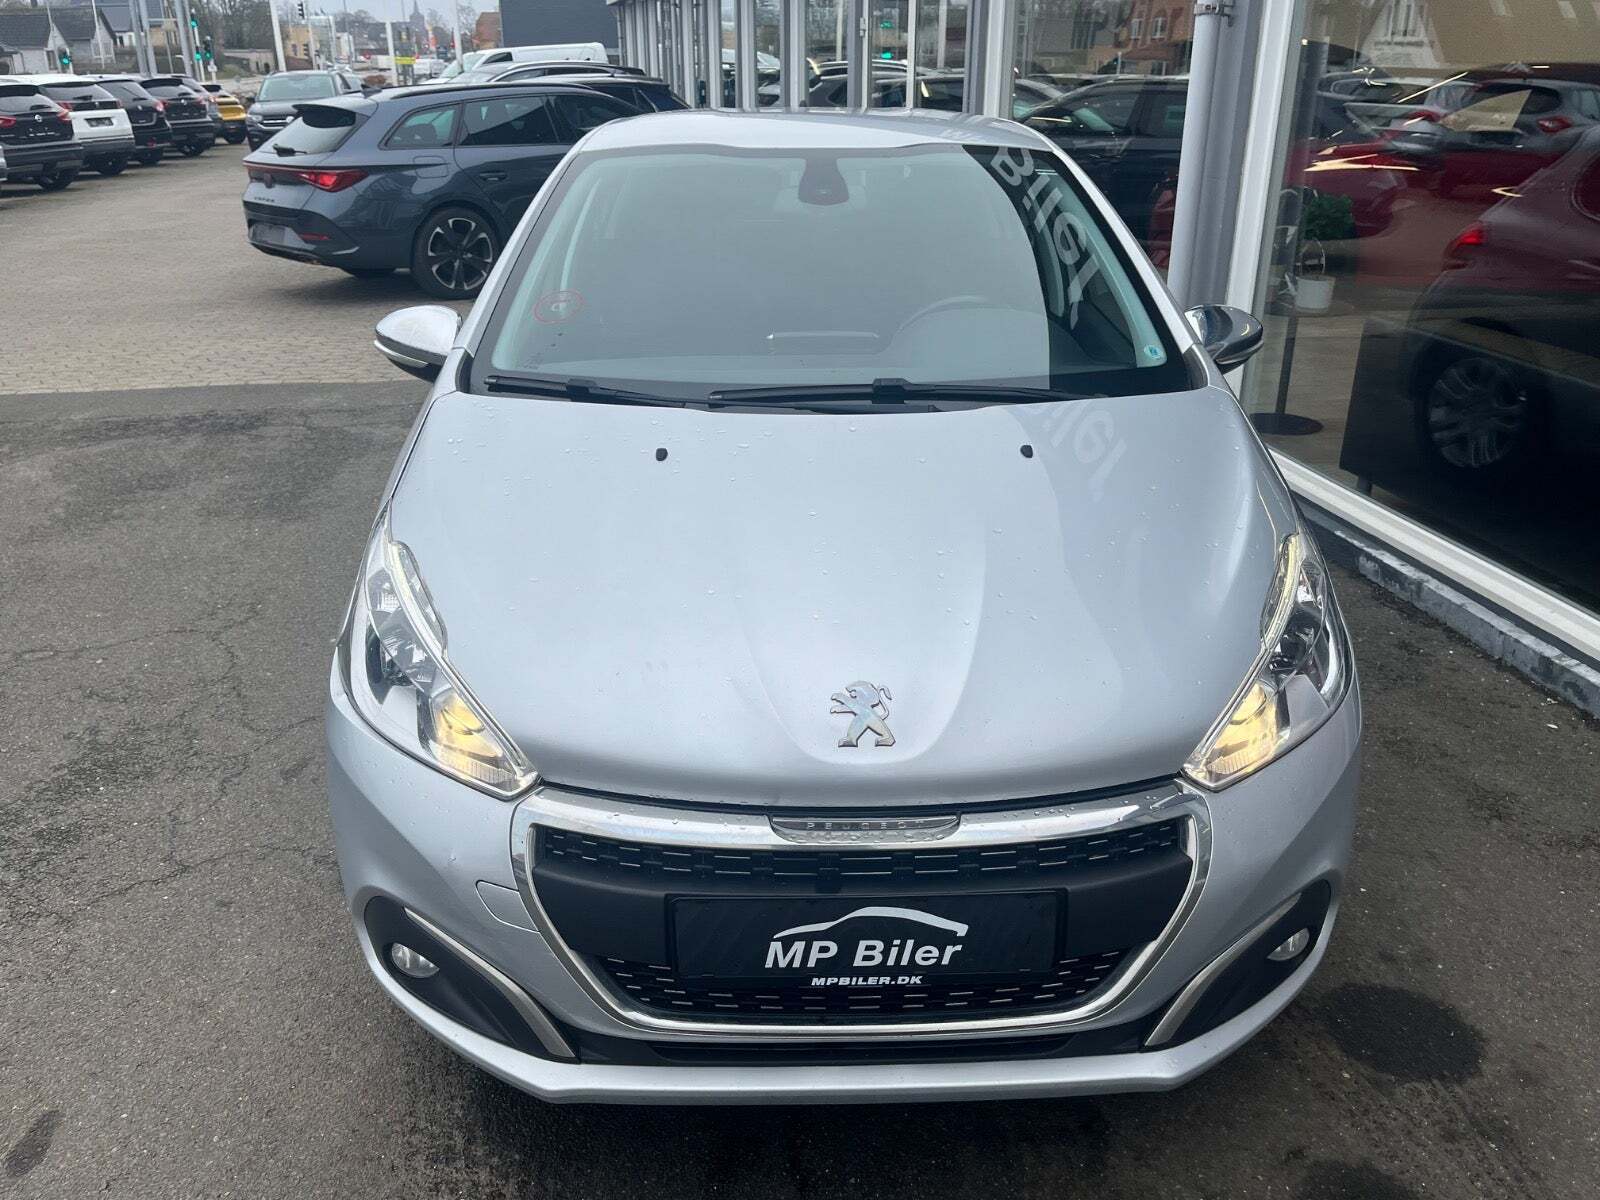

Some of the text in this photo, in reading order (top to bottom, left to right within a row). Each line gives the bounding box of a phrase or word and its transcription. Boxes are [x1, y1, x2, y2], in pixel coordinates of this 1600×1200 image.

[764, 938, 963, 969] MP Biler
[810, 975, 923, 986] MPBILER.DK
